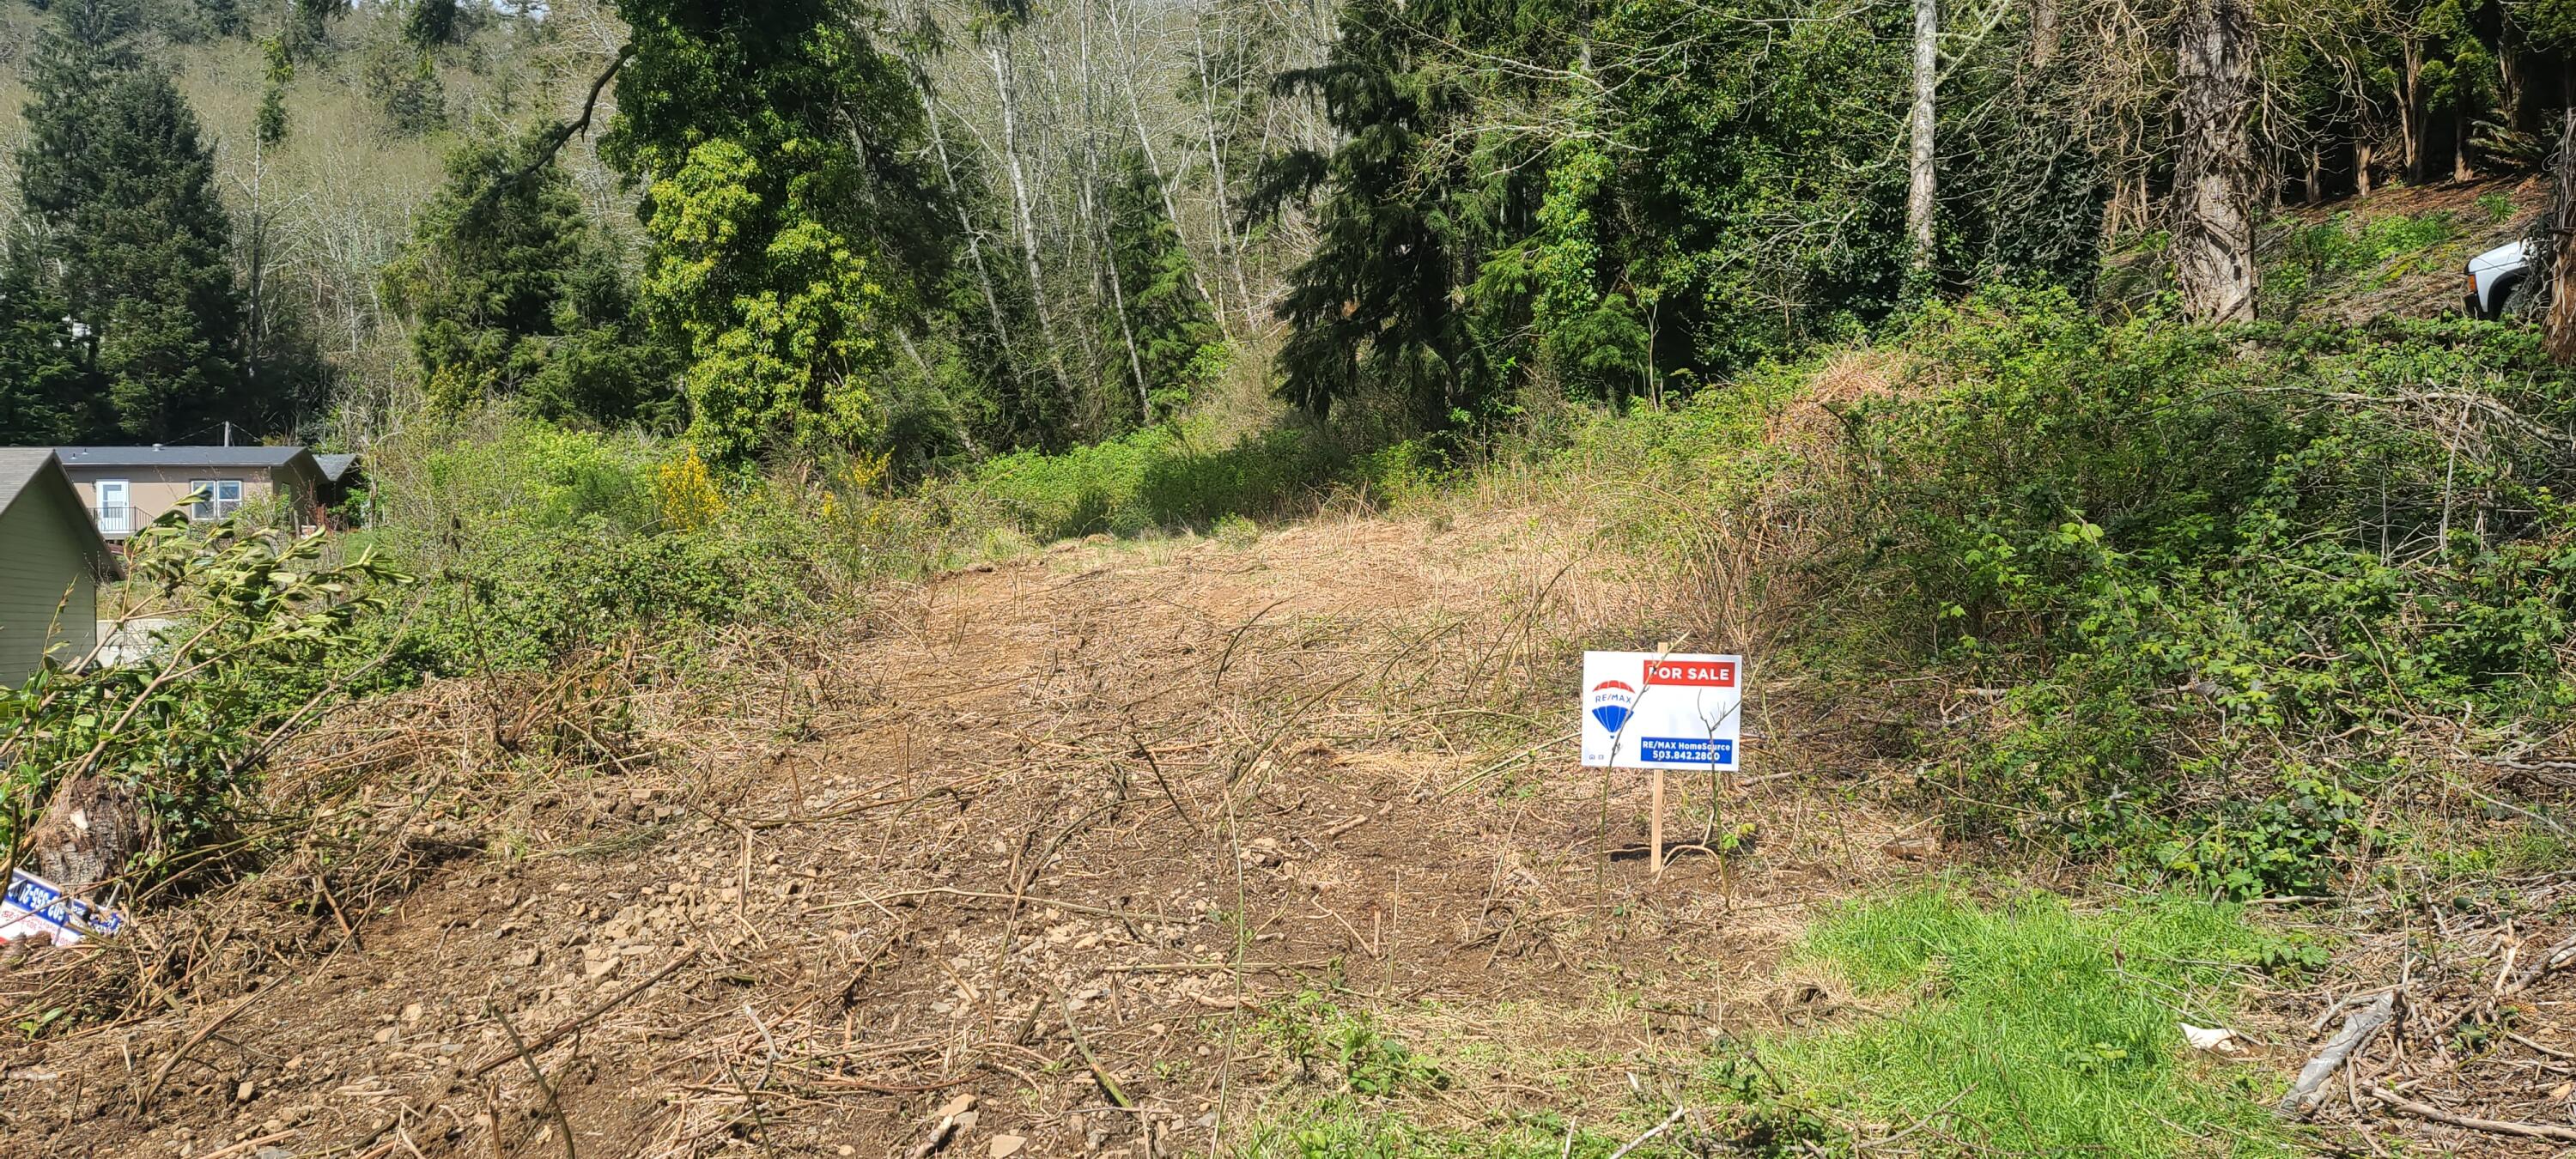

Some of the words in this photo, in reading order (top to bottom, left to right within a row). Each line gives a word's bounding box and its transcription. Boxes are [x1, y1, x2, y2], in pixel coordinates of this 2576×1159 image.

[1687, 668, 1729, 680] SALE
[1595, 694, 1631, 704] RE/MAX
[1643, 741, 1677, 749] RE/MAX
[1679, 742, 1731, 751] HomeSource
[1652, 751, 1721, 760] 503.842.2800
